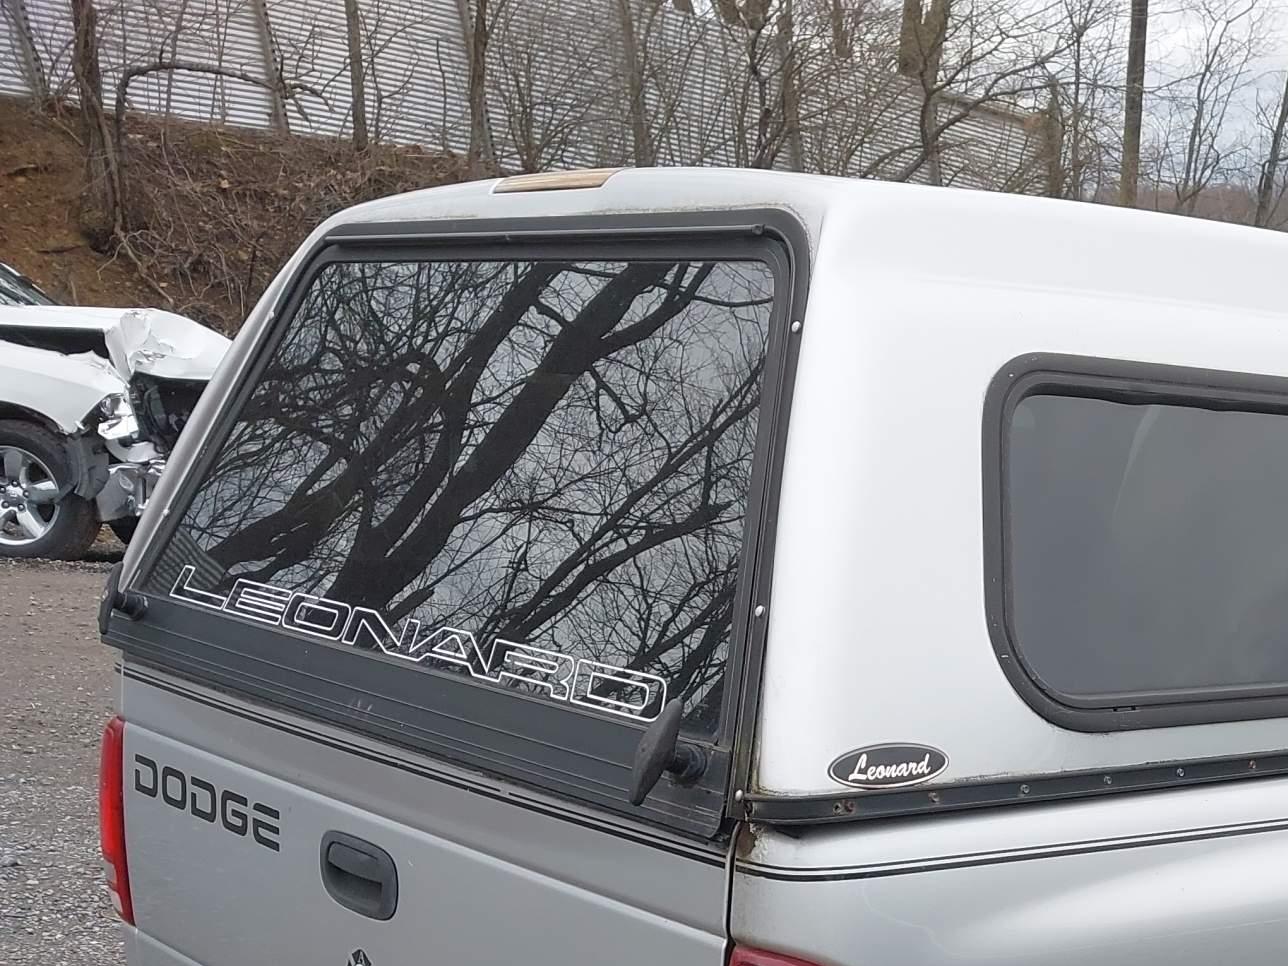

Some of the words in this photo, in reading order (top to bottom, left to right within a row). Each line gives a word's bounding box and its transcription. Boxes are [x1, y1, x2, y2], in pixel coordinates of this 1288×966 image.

[169, 565, 668, 723] LEONARD
[134, 753, 281, 853] DODGE
[847, 752, 932, 781] Leonard
